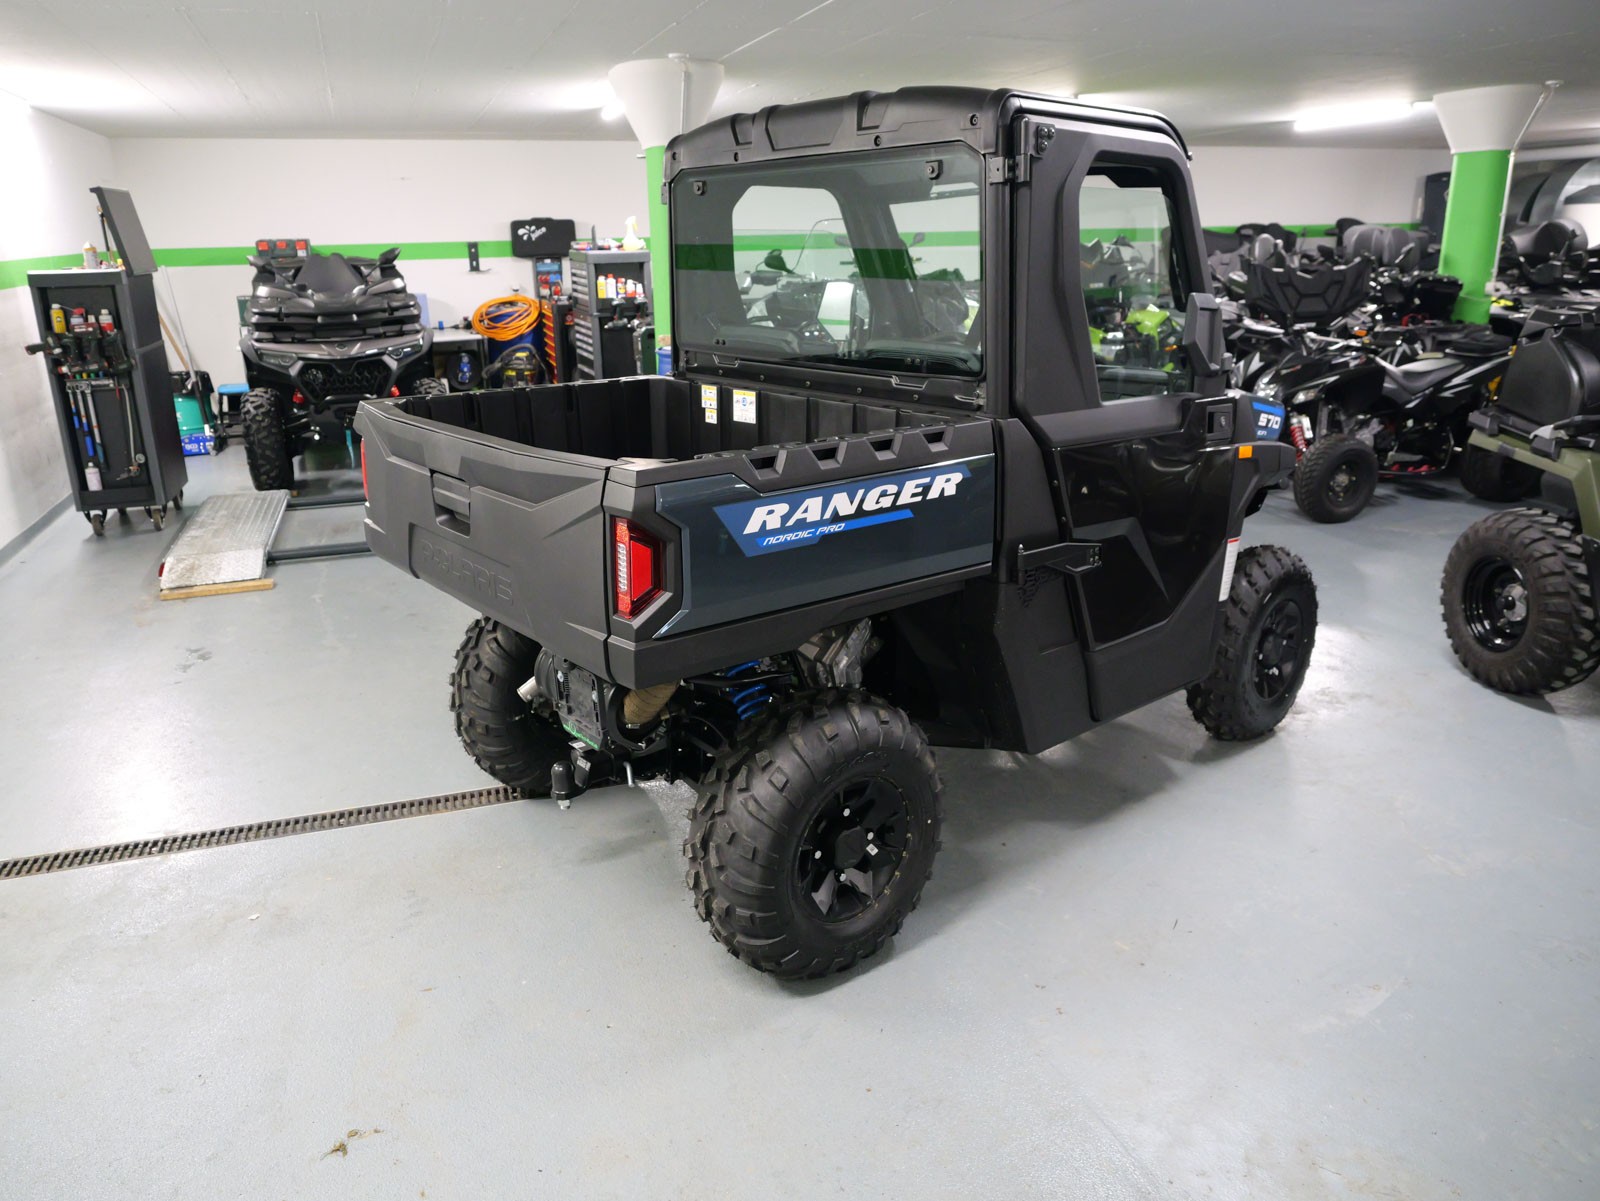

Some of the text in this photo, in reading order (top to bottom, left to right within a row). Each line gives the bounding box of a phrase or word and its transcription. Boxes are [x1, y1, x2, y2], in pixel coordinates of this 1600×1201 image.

[1258, 412, 1281, 429] 570
[743, 472, 963, 535] RANGER
[763, 522, 845, 546] NORDIC PRO
[421, 539, 514, 604] POLARIS
